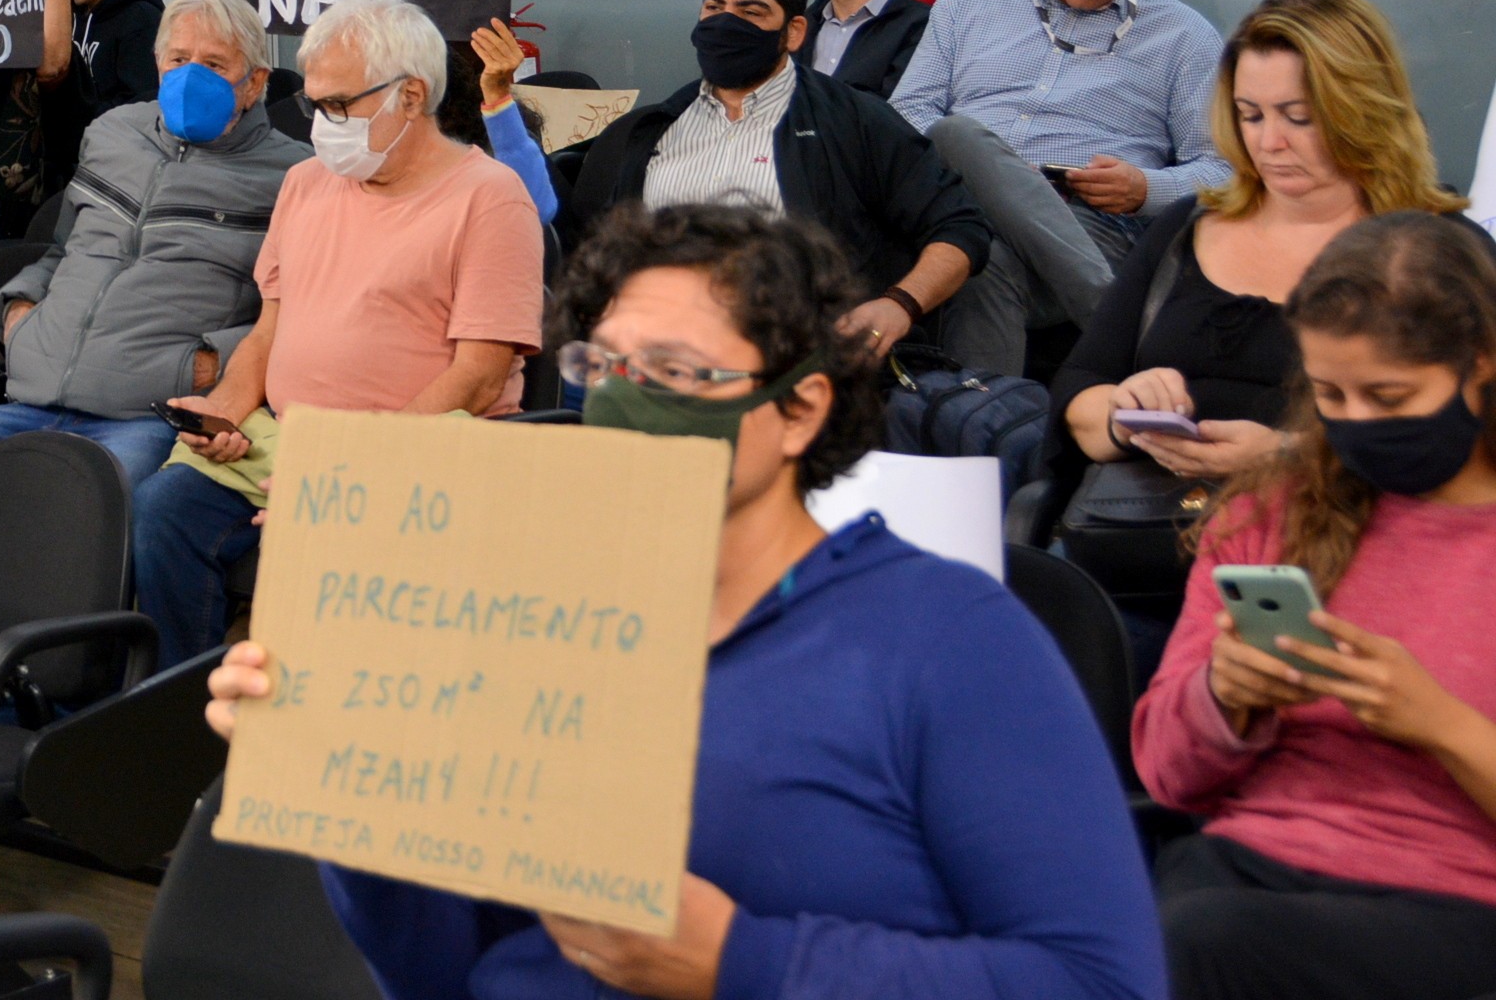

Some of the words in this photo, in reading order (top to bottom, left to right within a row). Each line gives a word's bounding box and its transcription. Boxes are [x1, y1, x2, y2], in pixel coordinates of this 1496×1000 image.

[293, 464, 367, 526] NÃO
[399, 482, 452, 534] AO
[314, 571, 645, 653] PARCELAMENTO
[272, 661, 313, 709] DE
[522, 690, 586, 741] NA
[234, 796, 374, 854] PROTEJA
[392, 827, 485, 874] NOSSO
[503, 849, 667, 918] MANANCIAL
